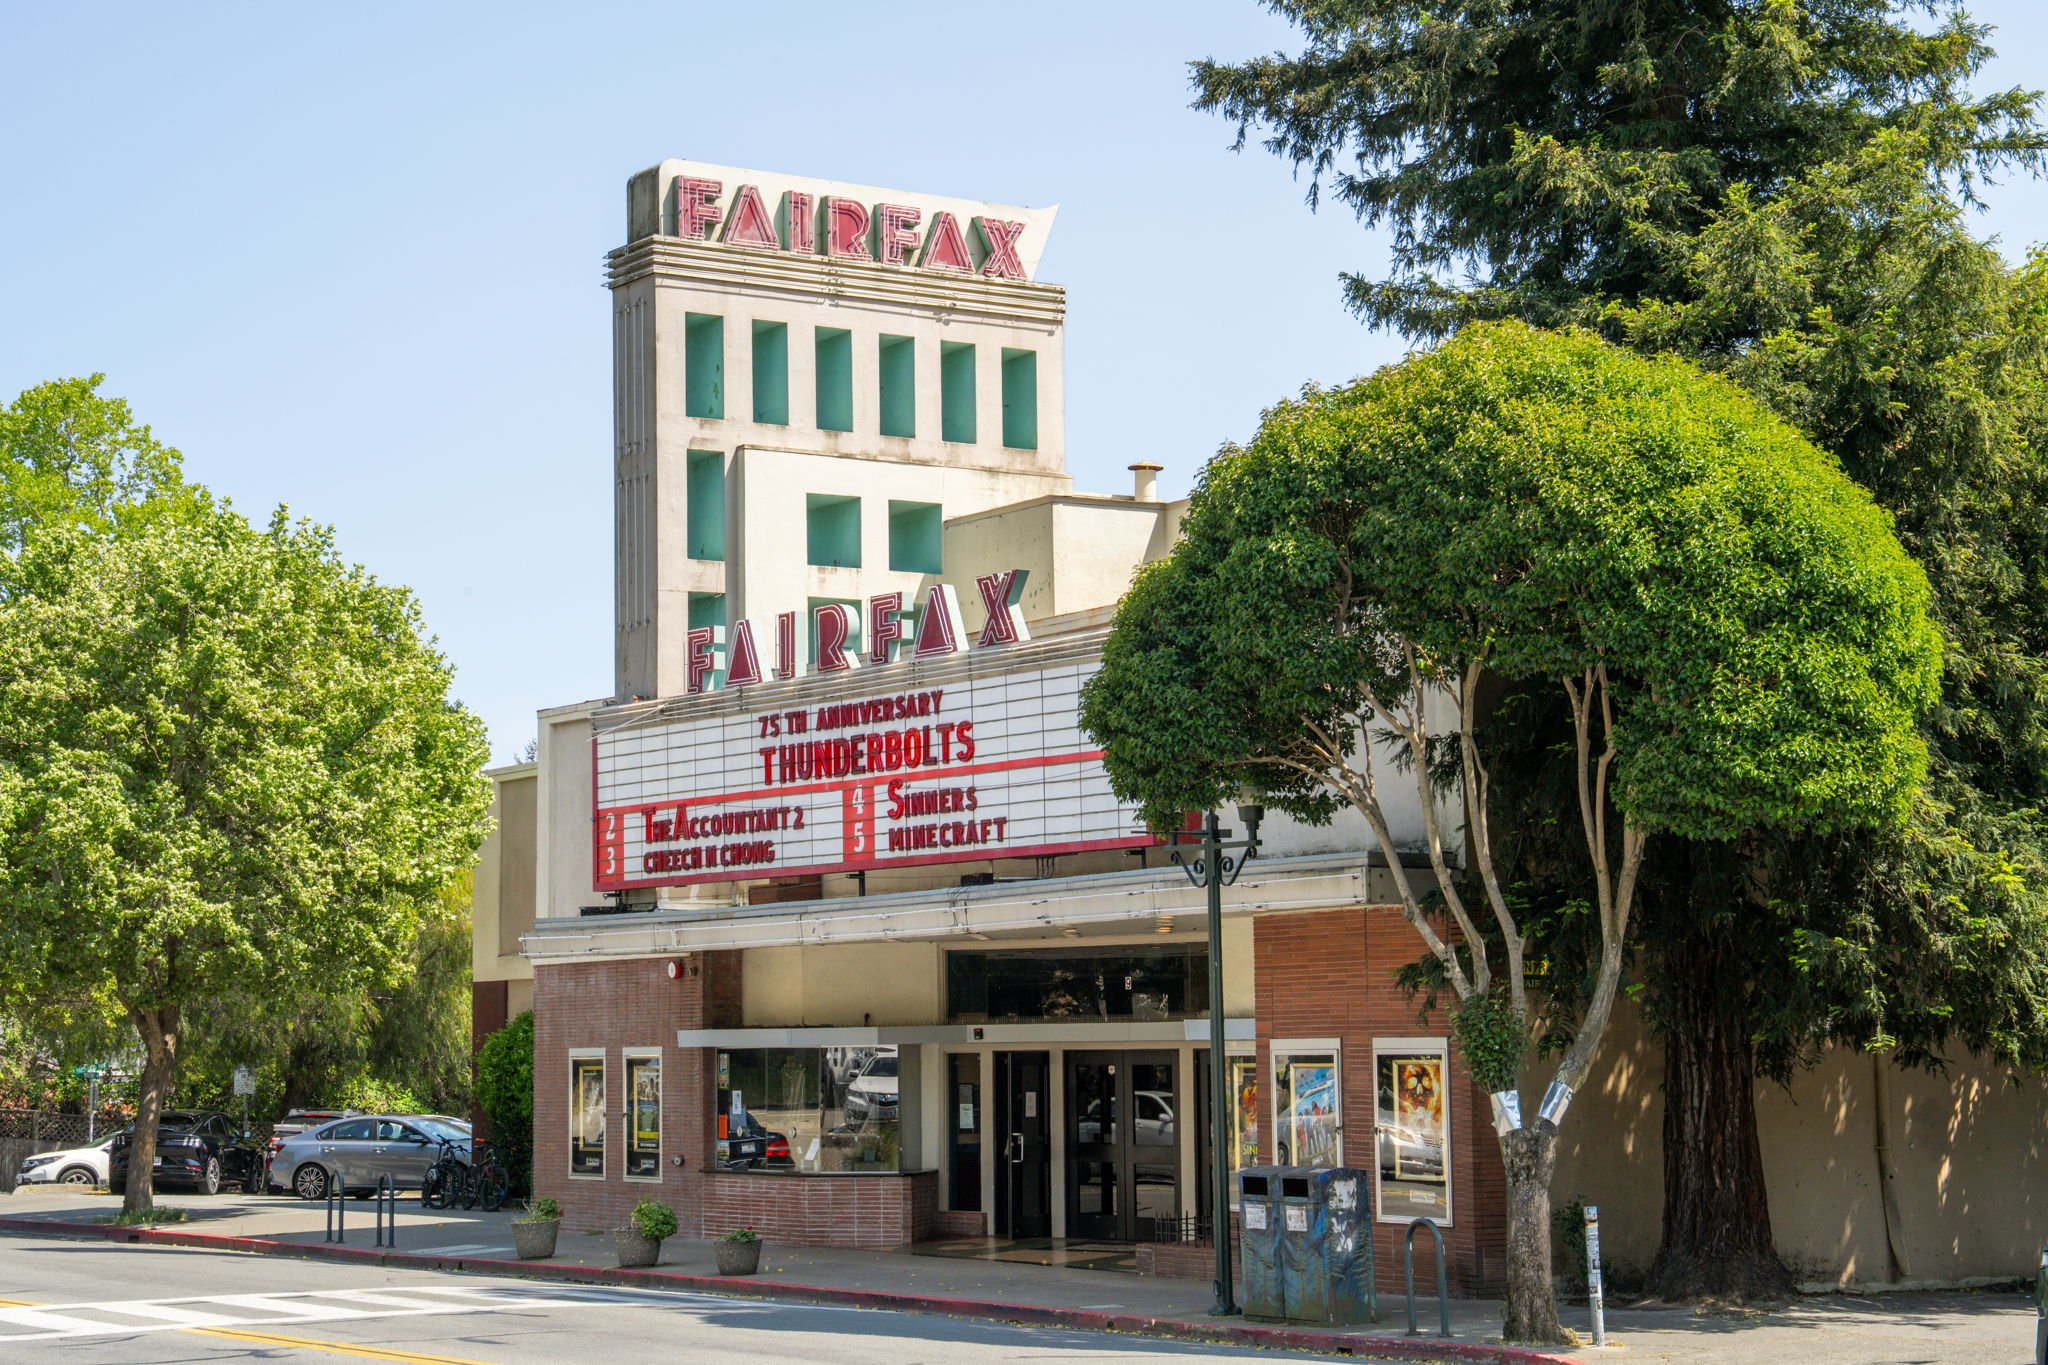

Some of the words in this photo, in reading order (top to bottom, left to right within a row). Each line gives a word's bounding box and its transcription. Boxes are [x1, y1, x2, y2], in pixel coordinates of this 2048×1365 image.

[674, 173, 1029, 281] FAIRFAX
[686, 568, 1031, 694] FAIRFAX
[815, 689, 944, 732] ANNIVERSARY
[759, 719, 976, 786] THUNDERBOLTS
[852, 784, 865, 815] 4
[887, 778, 979, 820] SINNERS
[605, 812, 616, 841] 2
[672, 803, 791, 841] ACCOUNTANT
[793, 805, 805, 831] 2
[854, 821, 866, 853] 5
[888, 816, 1008, 853] MINECRAFT
[605, 846, 616, 875] 3
[643, 845, 703, 874] CHEECH
[705, 843, 718, 869] N
[719, 839, 776, 866] CHONG
